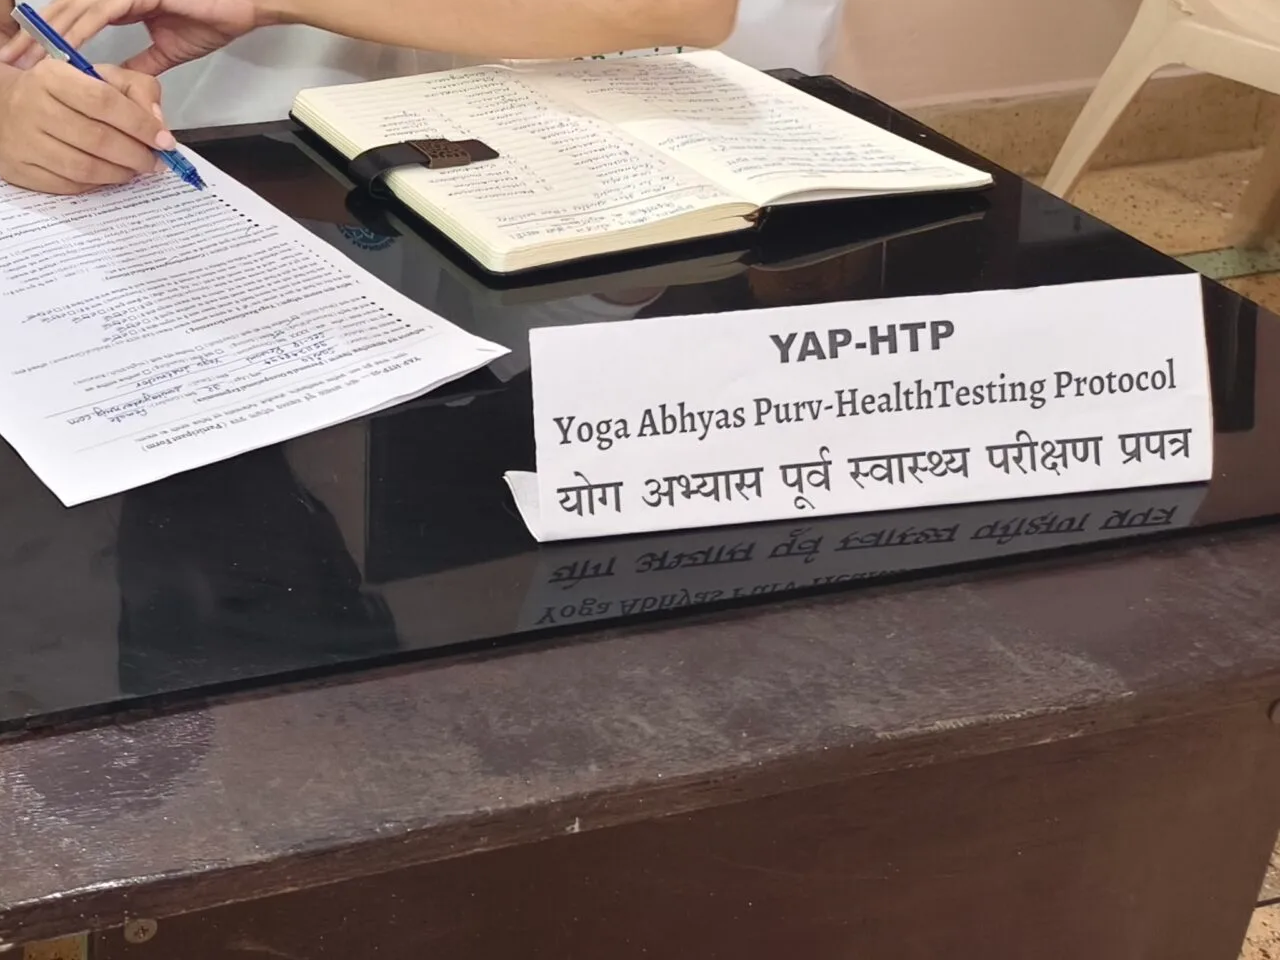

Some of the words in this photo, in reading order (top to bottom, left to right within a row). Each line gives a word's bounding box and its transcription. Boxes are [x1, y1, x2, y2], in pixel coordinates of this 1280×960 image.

[769, 320, 955, 363] YAP-HTP
[553, 415, 631, 451] Yoga
[637, 401, 746, 440] Abhyas
[753, 373, 1046, 426] Purv-HealthTesting
[1054, 358, 1177, 399] Protocol
[557, 471, 623, 517] योग
[642, 467, 764, 507] अभ्यास
[780, 445, 832, 511] पूर्व
[847, 447, 970, 489] स्वास्थ्य
[985, 429, 1103, 475] परीक्षण
[1118, 427, 1192, 464] प्रपत्र
